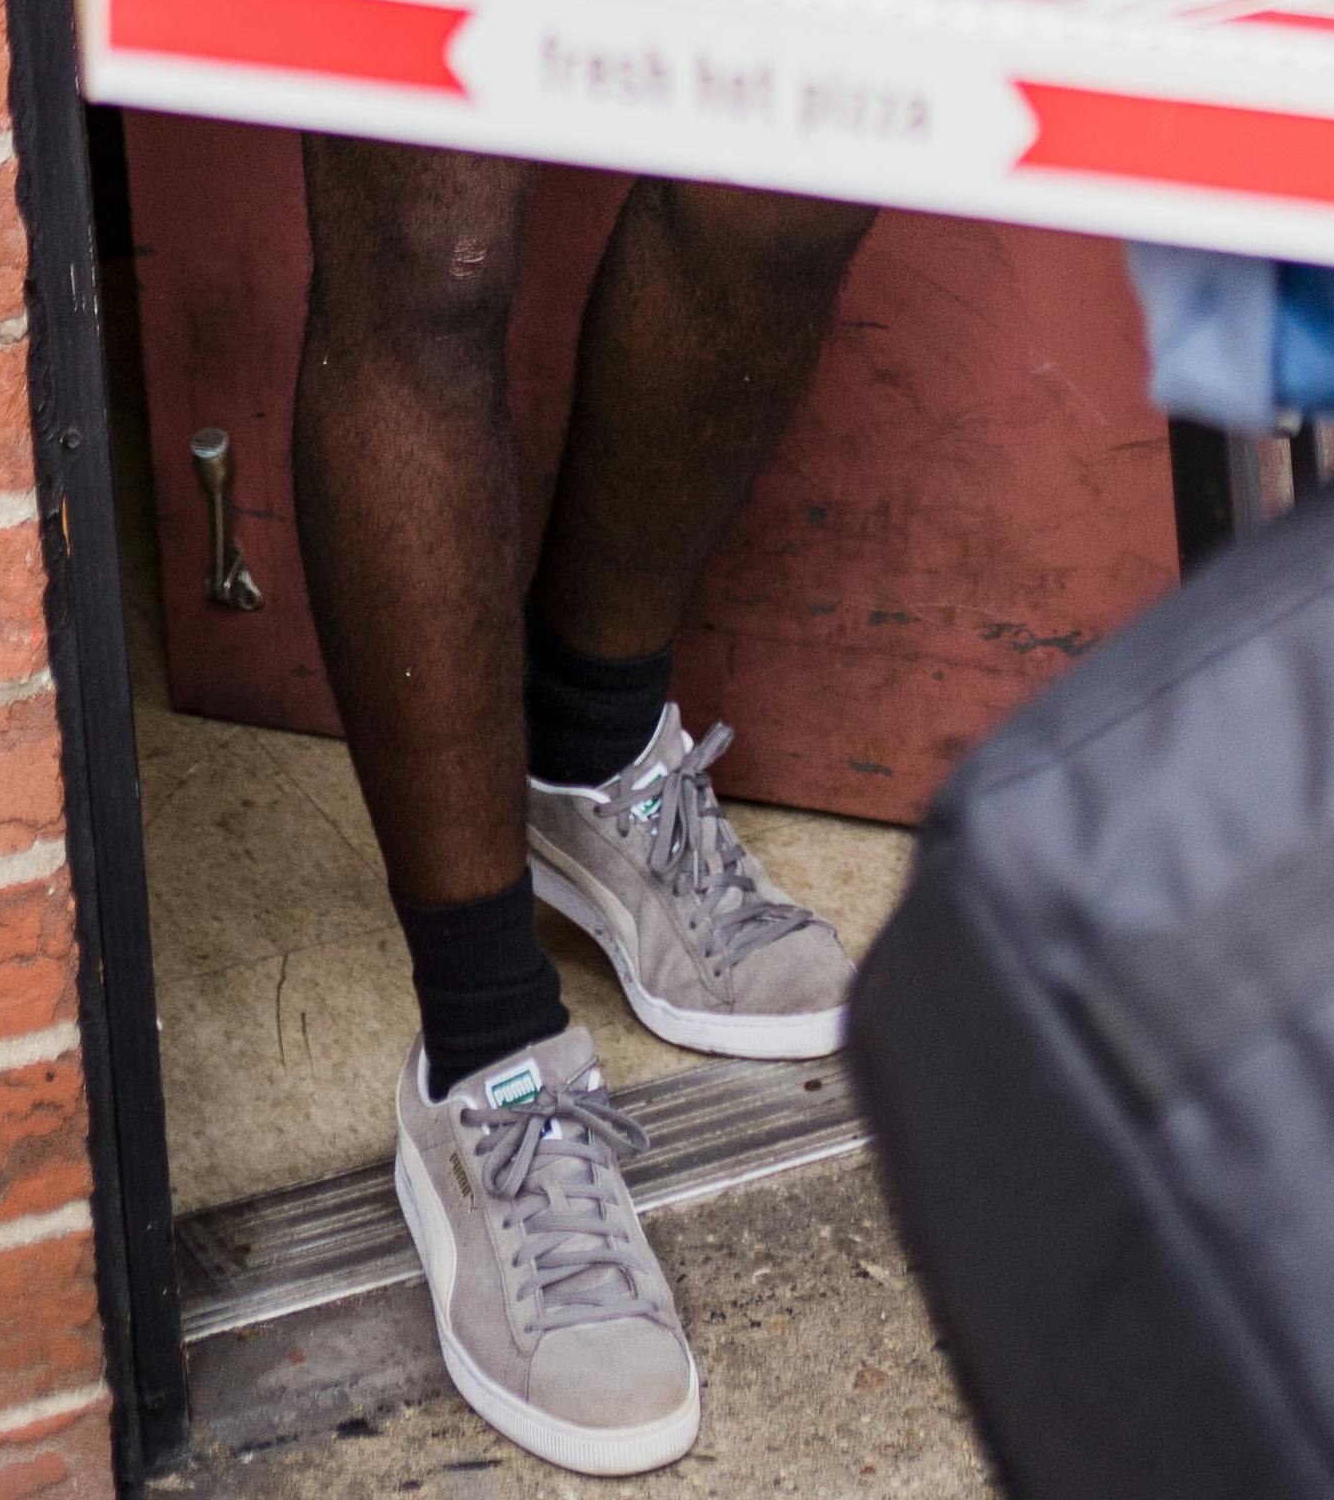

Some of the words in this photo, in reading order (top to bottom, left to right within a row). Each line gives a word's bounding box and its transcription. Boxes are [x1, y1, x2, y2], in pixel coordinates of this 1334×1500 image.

[539, 26, 672, 108] fresh
[693, 45, 778, 128] hot
[796, 64, 934, 144] pizza
